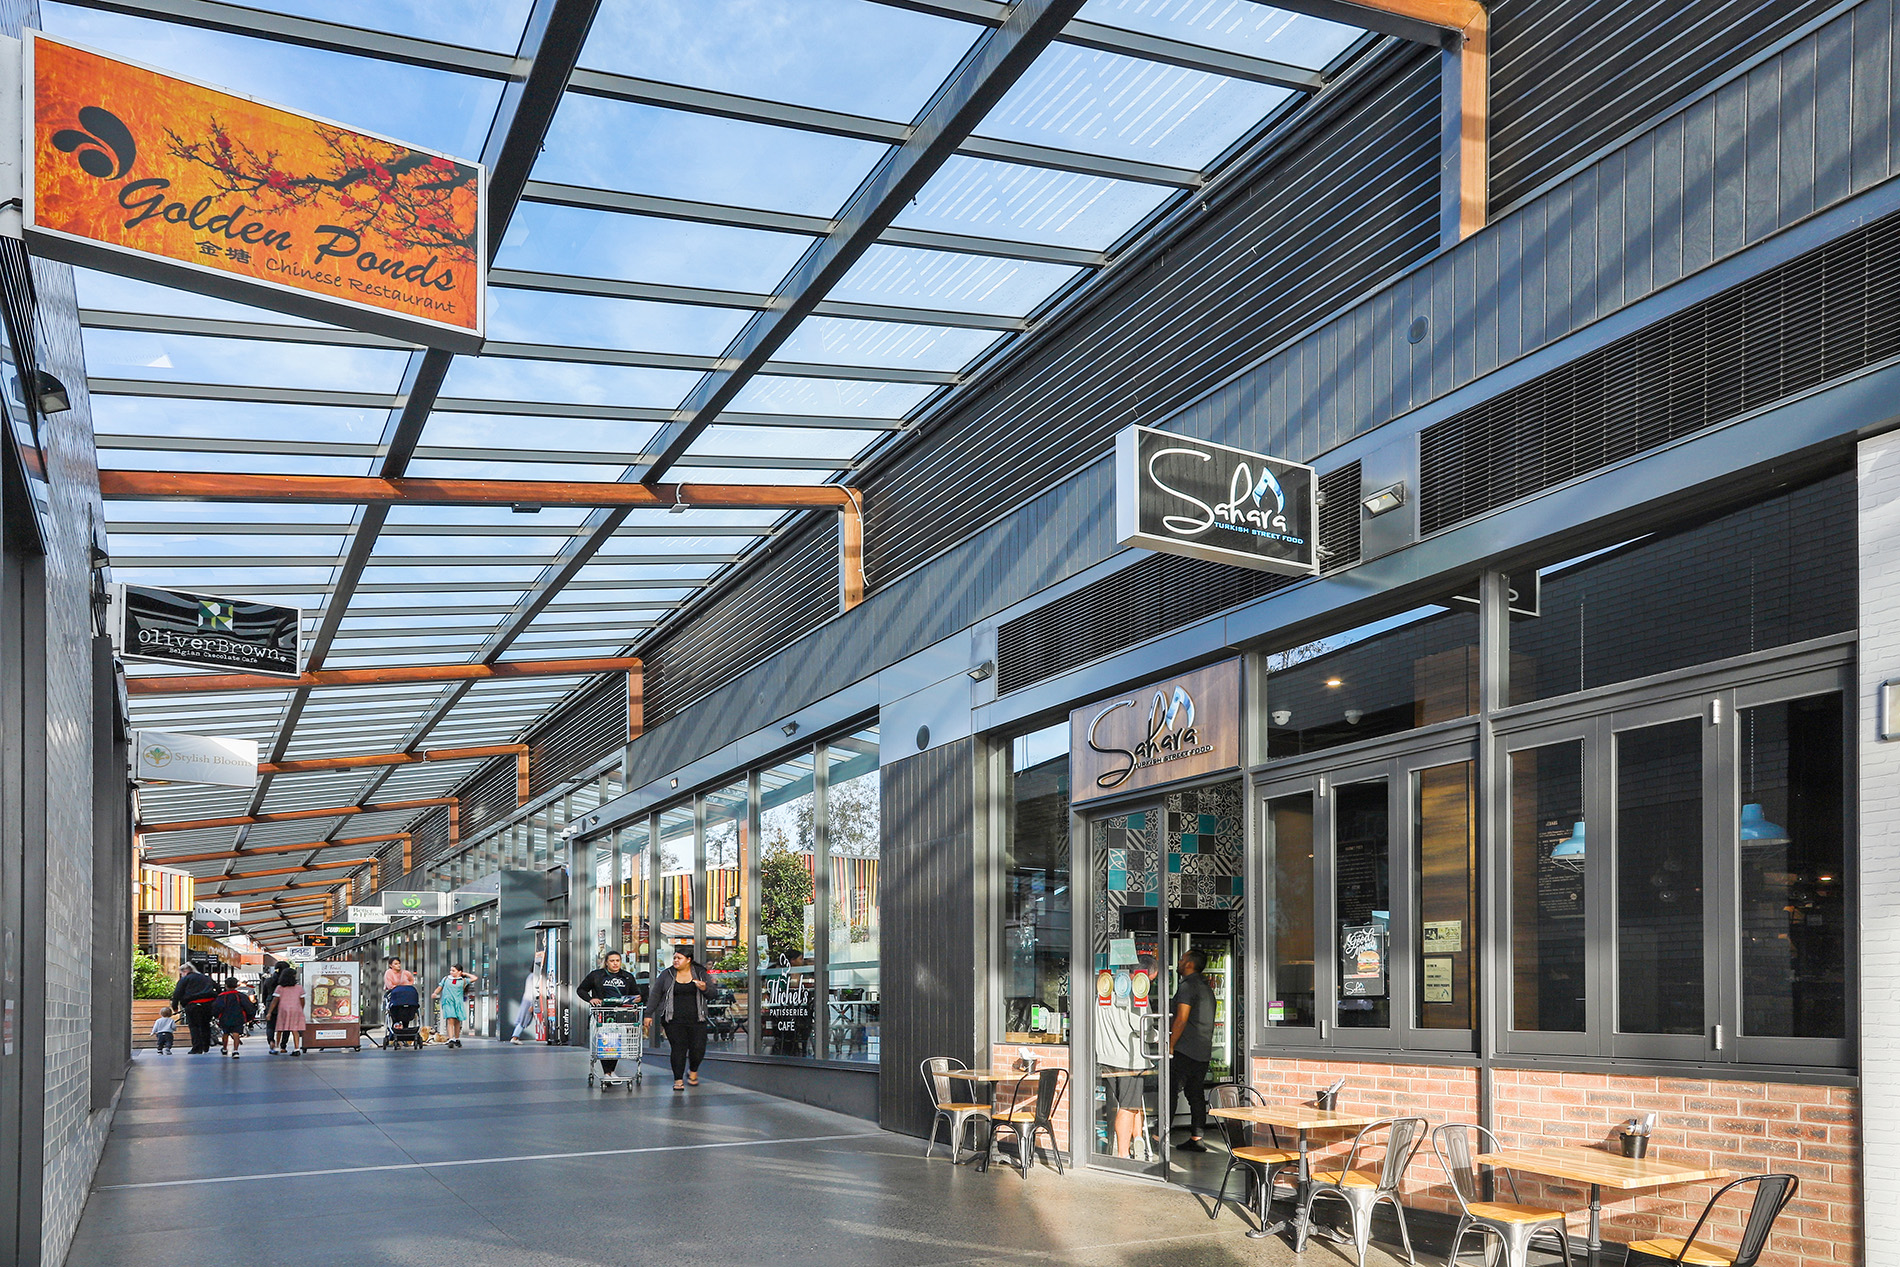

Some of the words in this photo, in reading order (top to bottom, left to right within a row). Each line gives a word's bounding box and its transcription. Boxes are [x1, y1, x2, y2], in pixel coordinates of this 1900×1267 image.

[119, 177, 292, 254] Golden
[313, 224, 456, 292] Ponds
[195, 239, 252, 265] 金塘
[266, 257, 343, 288] Chinese
[349, 277, 457, 315] Restaurant
[1149, 448, 1287, 535] Sahara
[1213, 521, 1249, 534] TURKISH
[1251, 529, 1281, 540] STREET
[1282, 535, 1304, 545] FOOD
[169, 647, 201, 657] Belgian
[203, 652, 241, 662] Chocolate
[1087, 690, 1199, 788] Sahara
[175, 753, 210, 766] Stylish
[213, 756, 253, 768] Blooms
[1134, 757, 1163, 770] TURKISH
[1163, 751, 1190, 763] STREET
[1191, 745, 1214, 757] FOOD
[765, 974, 809, 1005] Michel's
[777, 1018, 795, 1031] CAFÉ
